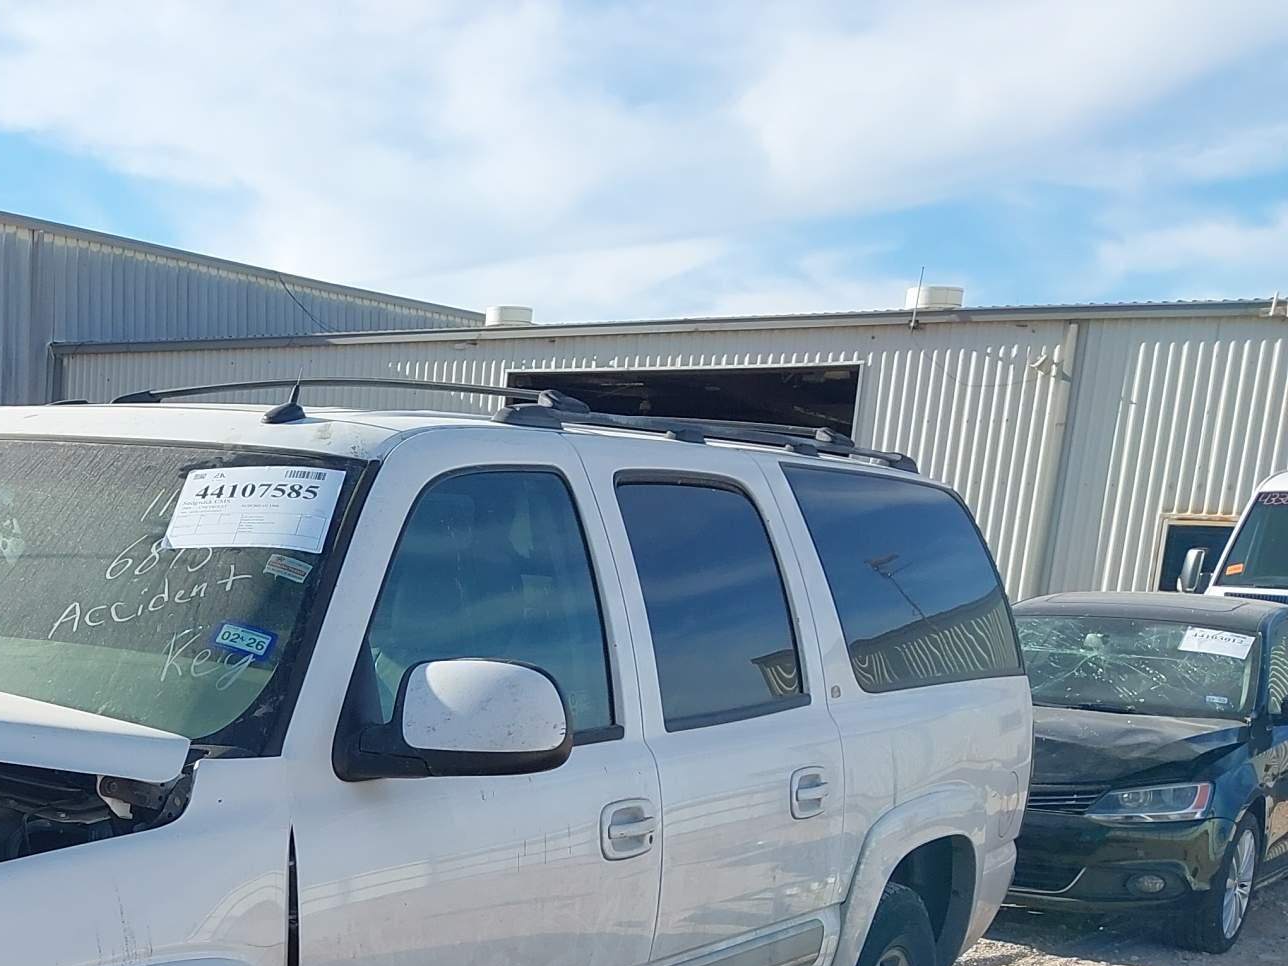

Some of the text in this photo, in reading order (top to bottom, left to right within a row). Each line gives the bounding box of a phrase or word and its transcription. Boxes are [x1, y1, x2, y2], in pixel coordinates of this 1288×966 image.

[194, 482, 321, 501] 44107585
[221, 630, 238, 644] 02
[245, 637, 266, 651] 26
